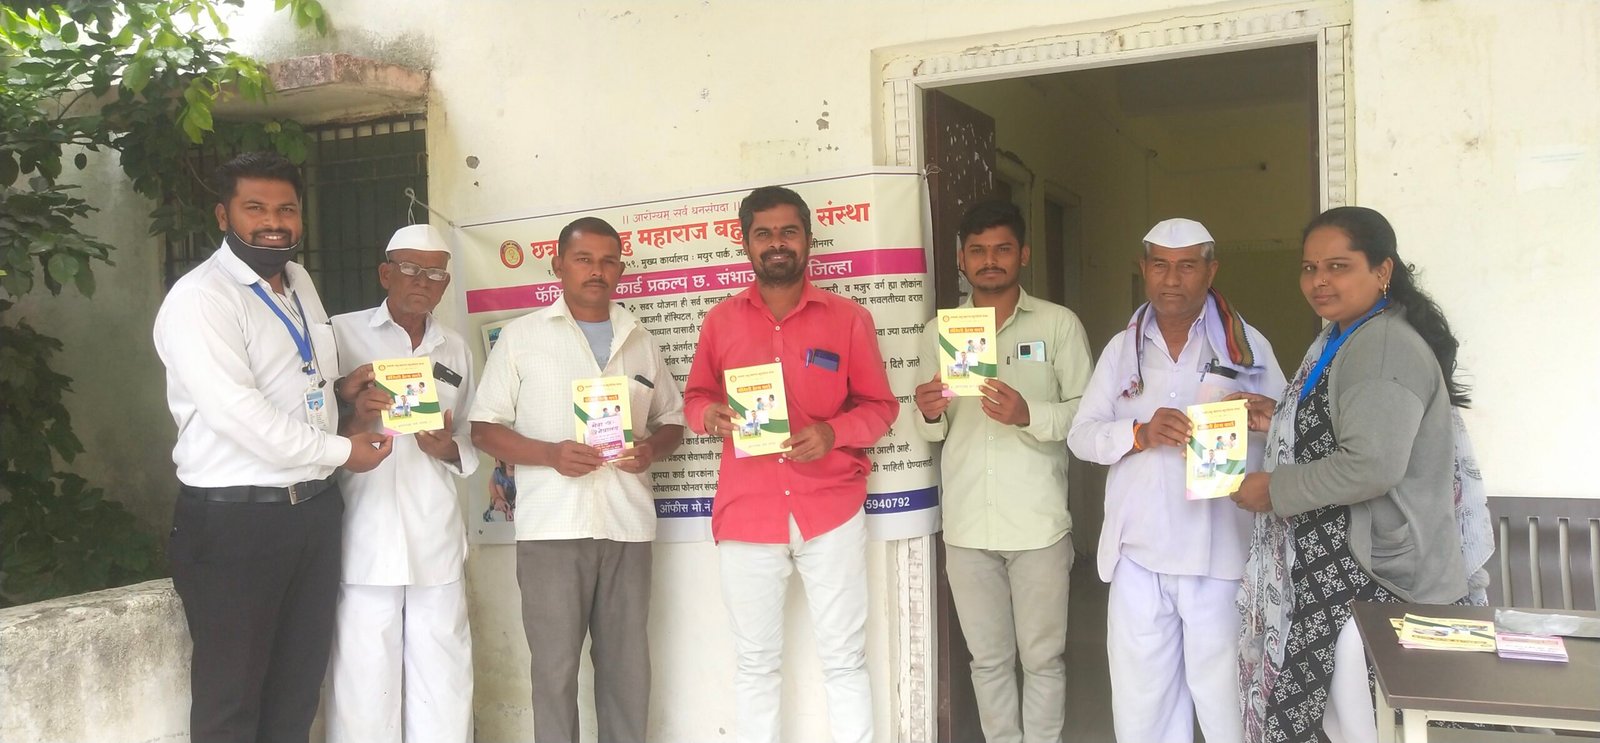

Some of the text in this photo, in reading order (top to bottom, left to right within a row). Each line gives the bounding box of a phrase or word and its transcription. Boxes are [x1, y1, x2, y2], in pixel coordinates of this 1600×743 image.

[637, 222, 708, 249] महाराज
[816, 200, 870, 227] संस्था
[641, 257, 658, 269] मुख्य
[660, 252, 689, 265] कार्यालय
[697, 252, 713, 263] मयुर
[534, 285, 565, 303] फॅमि
[615, 275, 644, 295] कार्ड
[647, 276, 688, 293] प्रकल्प
[807, 258, 853, 277] जिल्हा
[639, 302, 654, 311] सदर
[656, 299, 678, 309] योजना
[853, 283, 871, 294] मजुर
[873, 278, 885, 290] वर्ग
[900, 277, 923, 289] लोकांना
[640, 312, 662, 323] खाजगी
[876, 443, 896, 454] आली
[882, 460, 905, 472] माहिती
[659, 500, 689, 514] ऑफीस
[865, 496, 910, 510] 5940792
